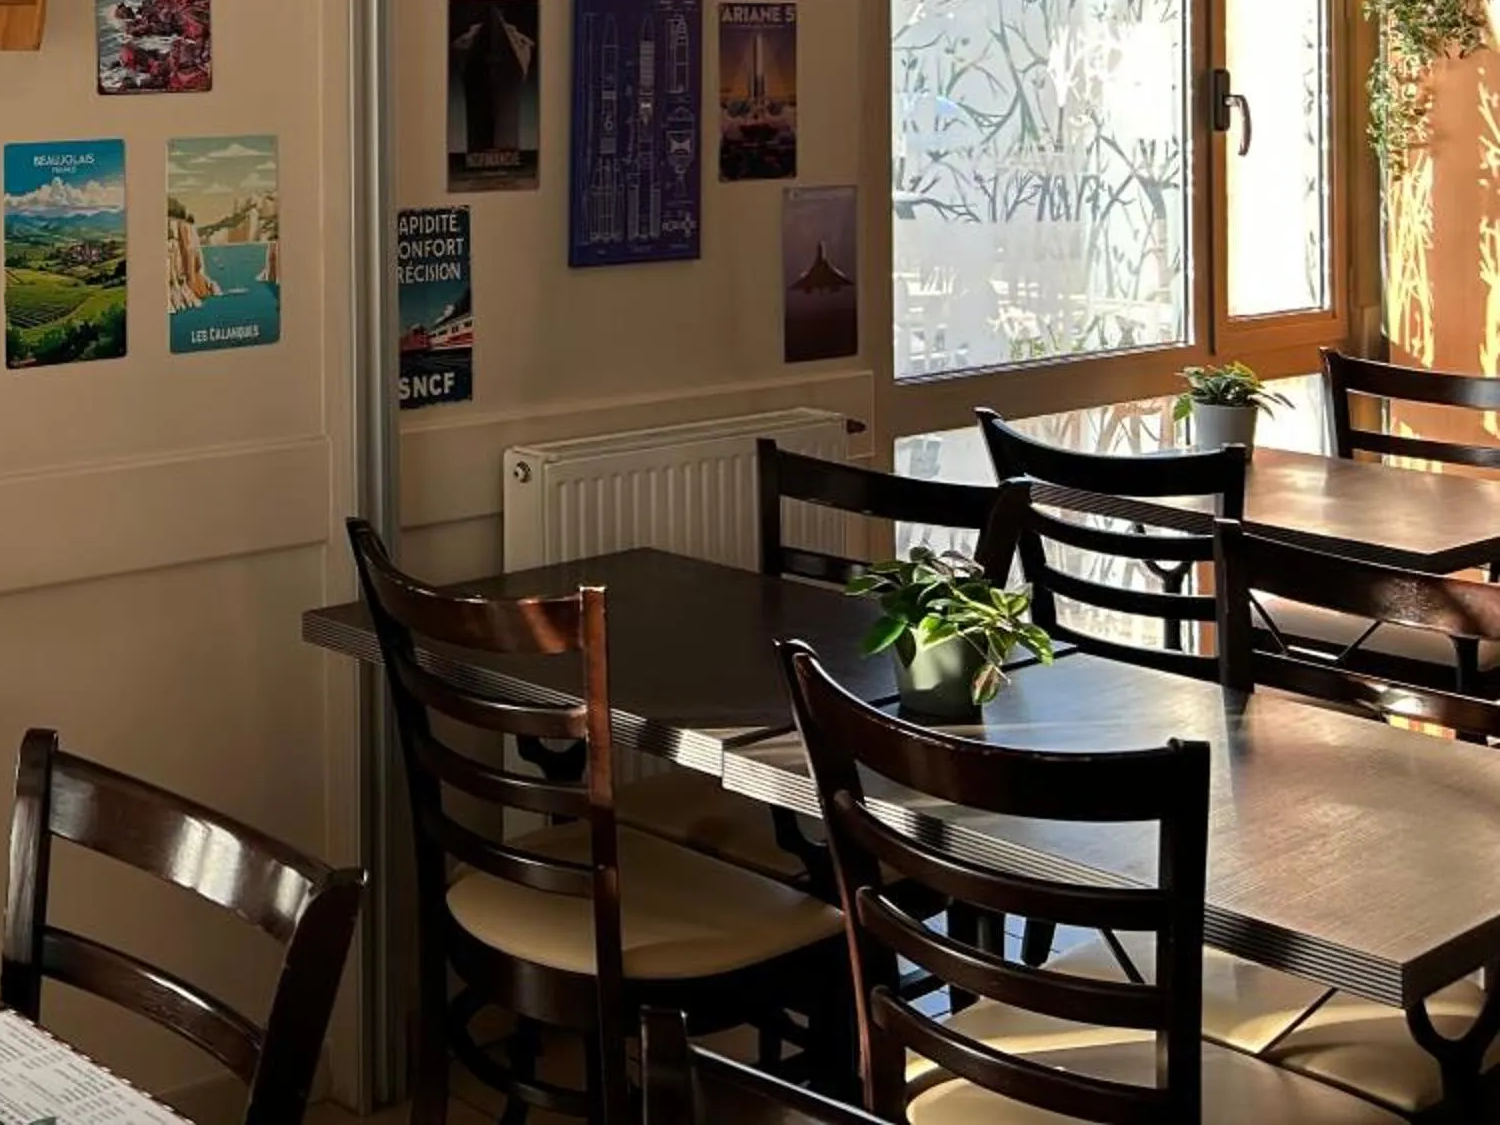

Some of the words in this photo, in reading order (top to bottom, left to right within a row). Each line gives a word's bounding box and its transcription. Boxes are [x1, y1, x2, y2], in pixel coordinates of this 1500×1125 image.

[722, 6, 782, 24] ARIANE
[399, 238, 464, 260] ONFORT
[397, 259, 461, 284] RÉCISION
[191, 330, 208, 344] LES
[398, 372, 455, 400] SNCF
